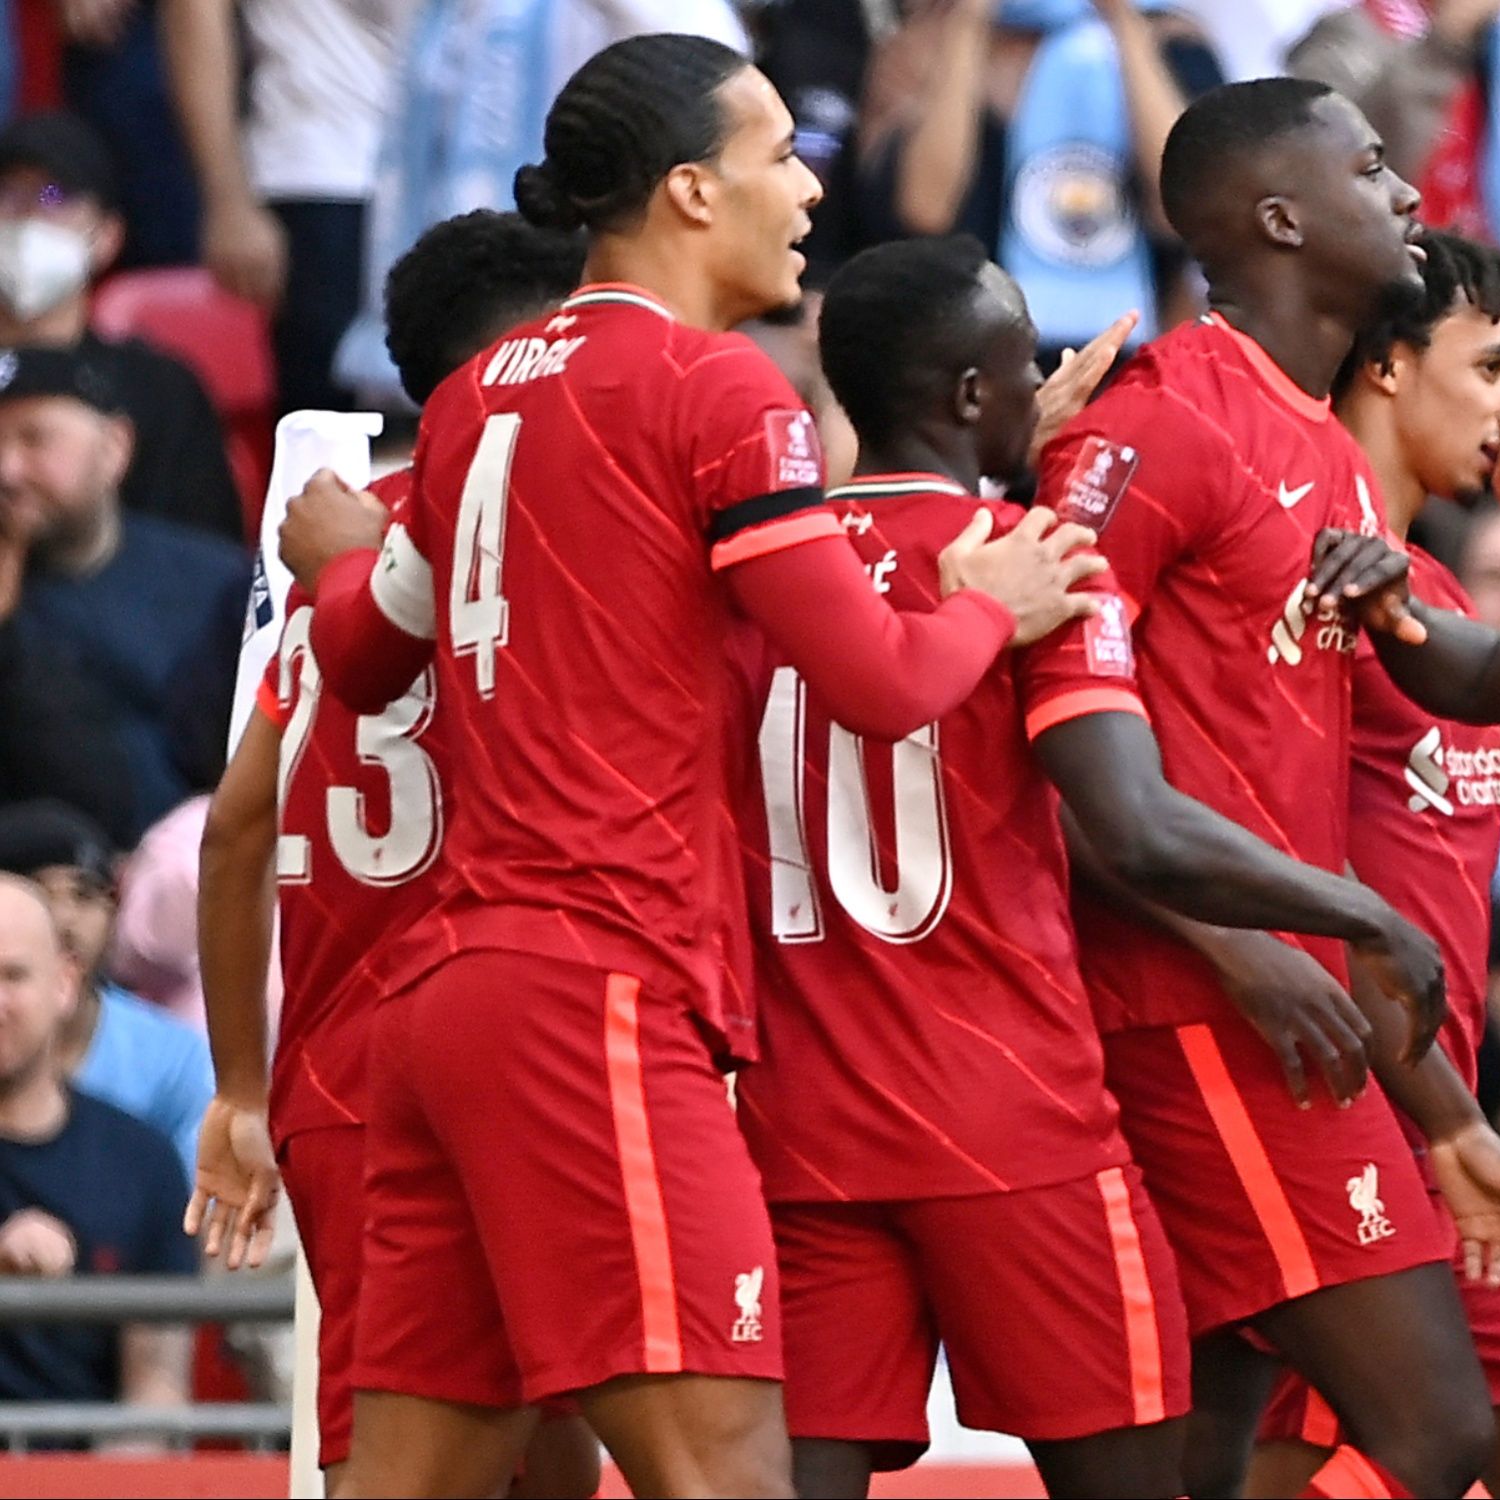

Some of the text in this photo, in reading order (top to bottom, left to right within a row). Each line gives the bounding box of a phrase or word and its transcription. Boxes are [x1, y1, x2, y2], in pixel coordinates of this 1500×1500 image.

[450, 411, 523, 701] 4
[276, 604, 444, 888] 23
[757, 665, 954, 944] 10
